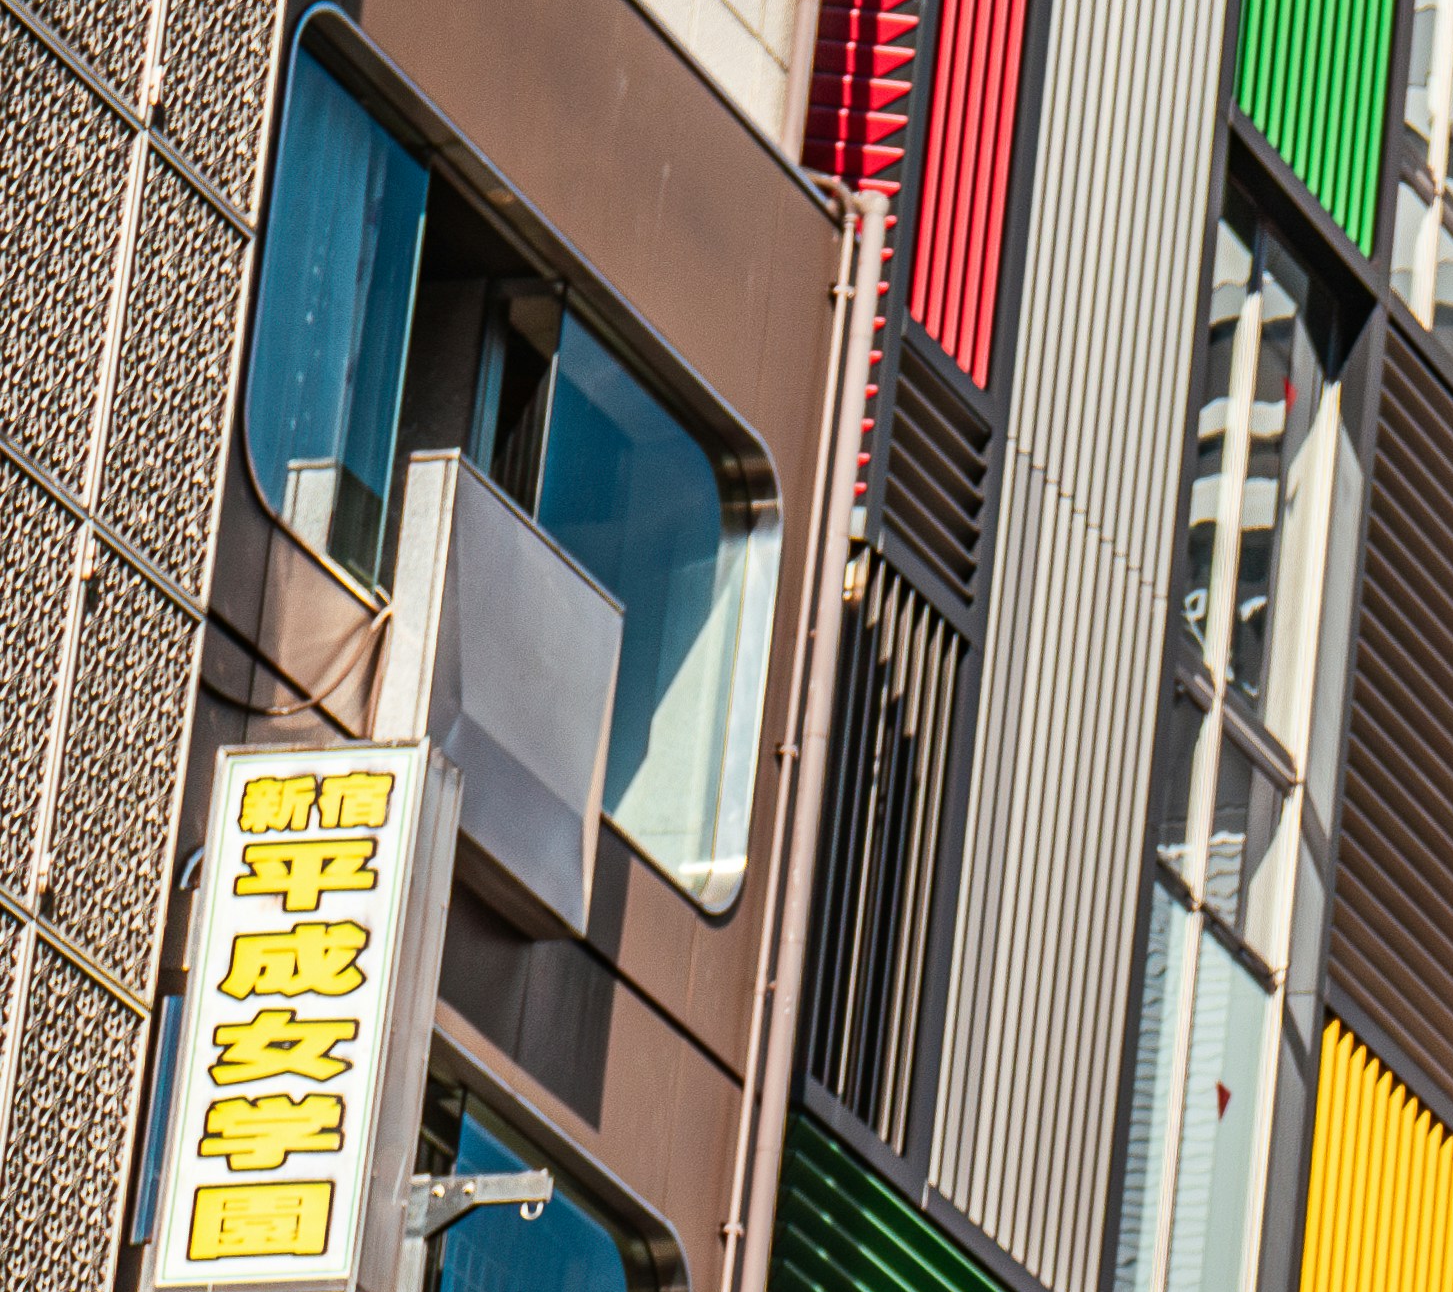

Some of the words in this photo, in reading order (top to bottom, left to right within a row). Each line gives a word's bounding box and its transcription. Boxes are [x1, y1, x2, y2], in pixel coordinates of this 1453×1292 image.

[238, 771, 394, 833] 新宿
[187, 838, 378, 1262] 平成女学園
